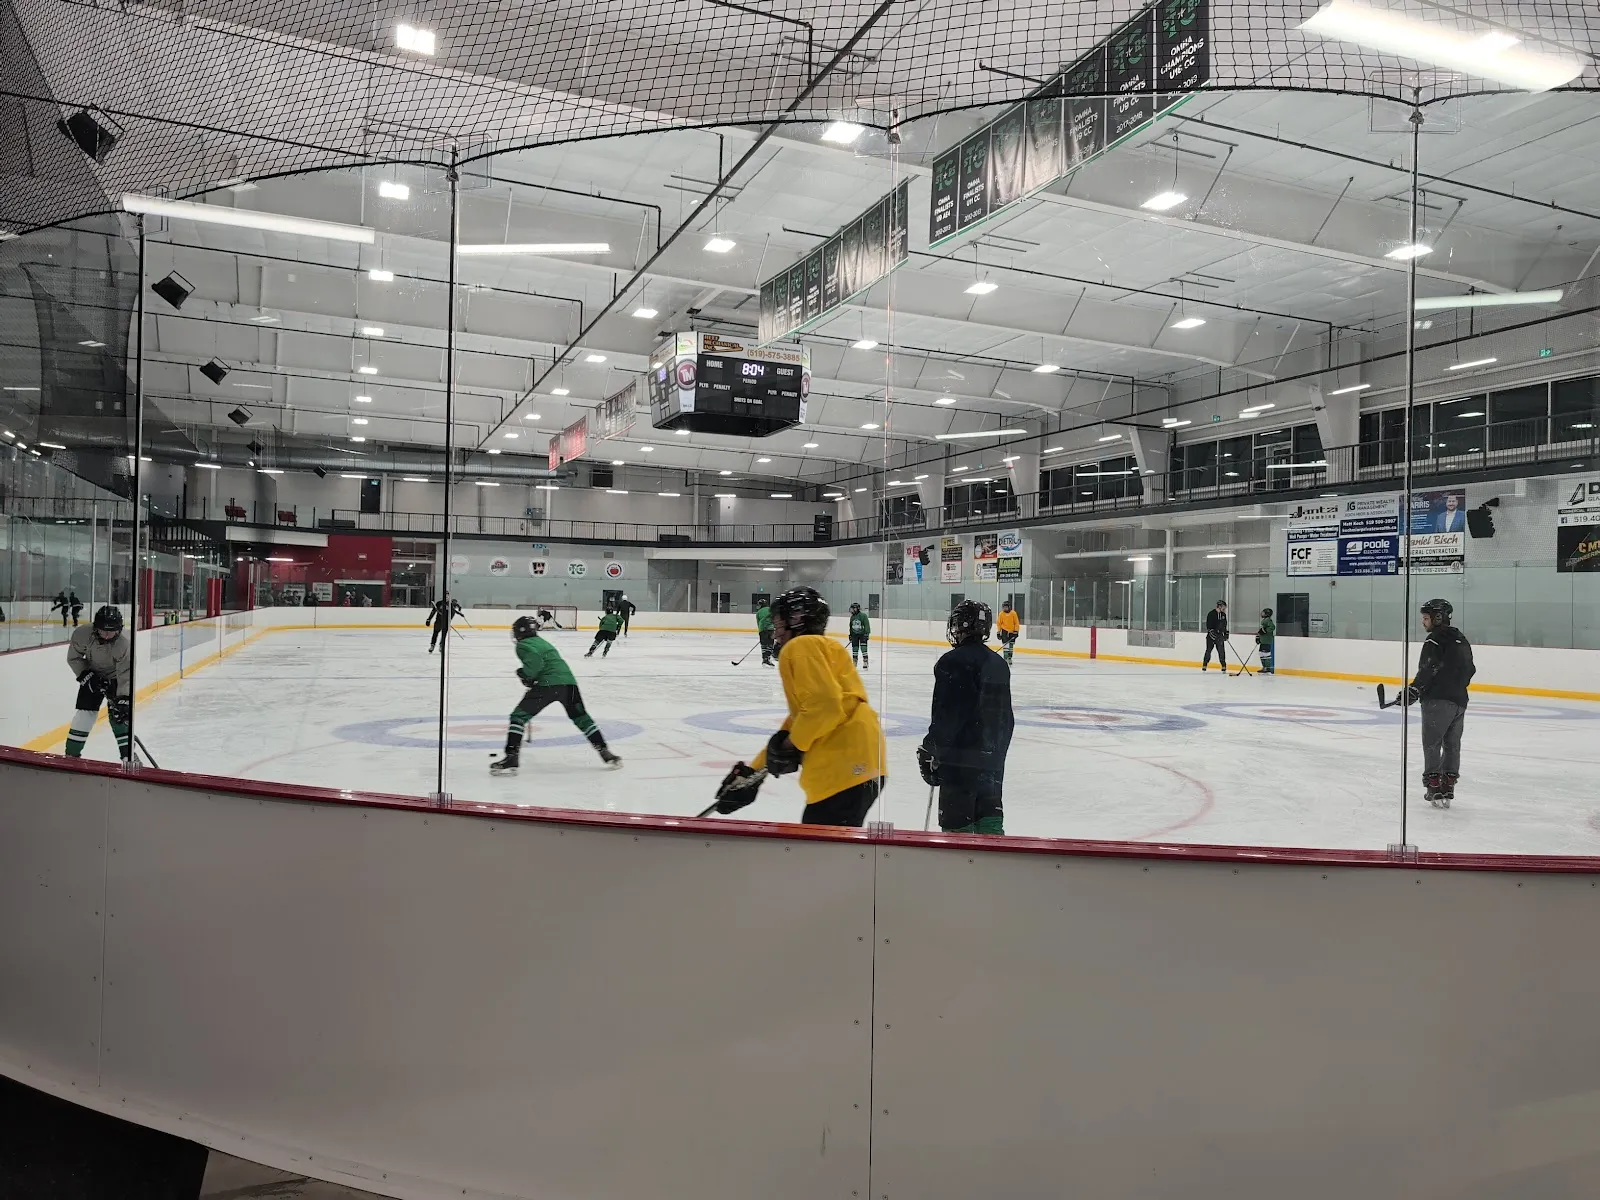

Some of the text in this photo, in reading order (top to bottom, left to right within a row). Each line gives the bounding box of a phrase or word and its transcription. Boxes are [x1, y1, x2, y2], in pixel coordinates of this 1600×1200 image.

[1170, 35, 1193, 56] OMHA
[1160, 38, 1204, 75] CHAMPIONS
[1184, 56, 1195, 69] CC
[1113, 80, 1146, 107] FINASTS
[1074, 107, 1092, 123] OMHA
[1069, 112, 1098, 136] FINALISTS
[1116, 111, 1143, 133] 2017-2018
[1074, 126, 1092, 142] U9 CC
[967, 177, 980, 190] OMHA
[963, 183, 985, 200] FINALISTS
[937, 195, 950, 206] OMHA
[974, 194, 981, 203] CC
[934, 200, 954, 215] FINALISTS
[747, 349, 800, 361] (519)-575-3885
[706, 359, 723, 369] HOME
[742, 363, 764, 376] 8:04
[776, 367, 794, 377] GUEST
[713, 383, 731, 391] PENALTY
[1347, 502, 1356, 512] IG
[1411, 500, 1430, 509] ARRIS
[1363, 539, 1390, 549] Poole
[1411, 534, 1458, 546] aniel Bisch
[1291, 548, 1312, 560] FCF
